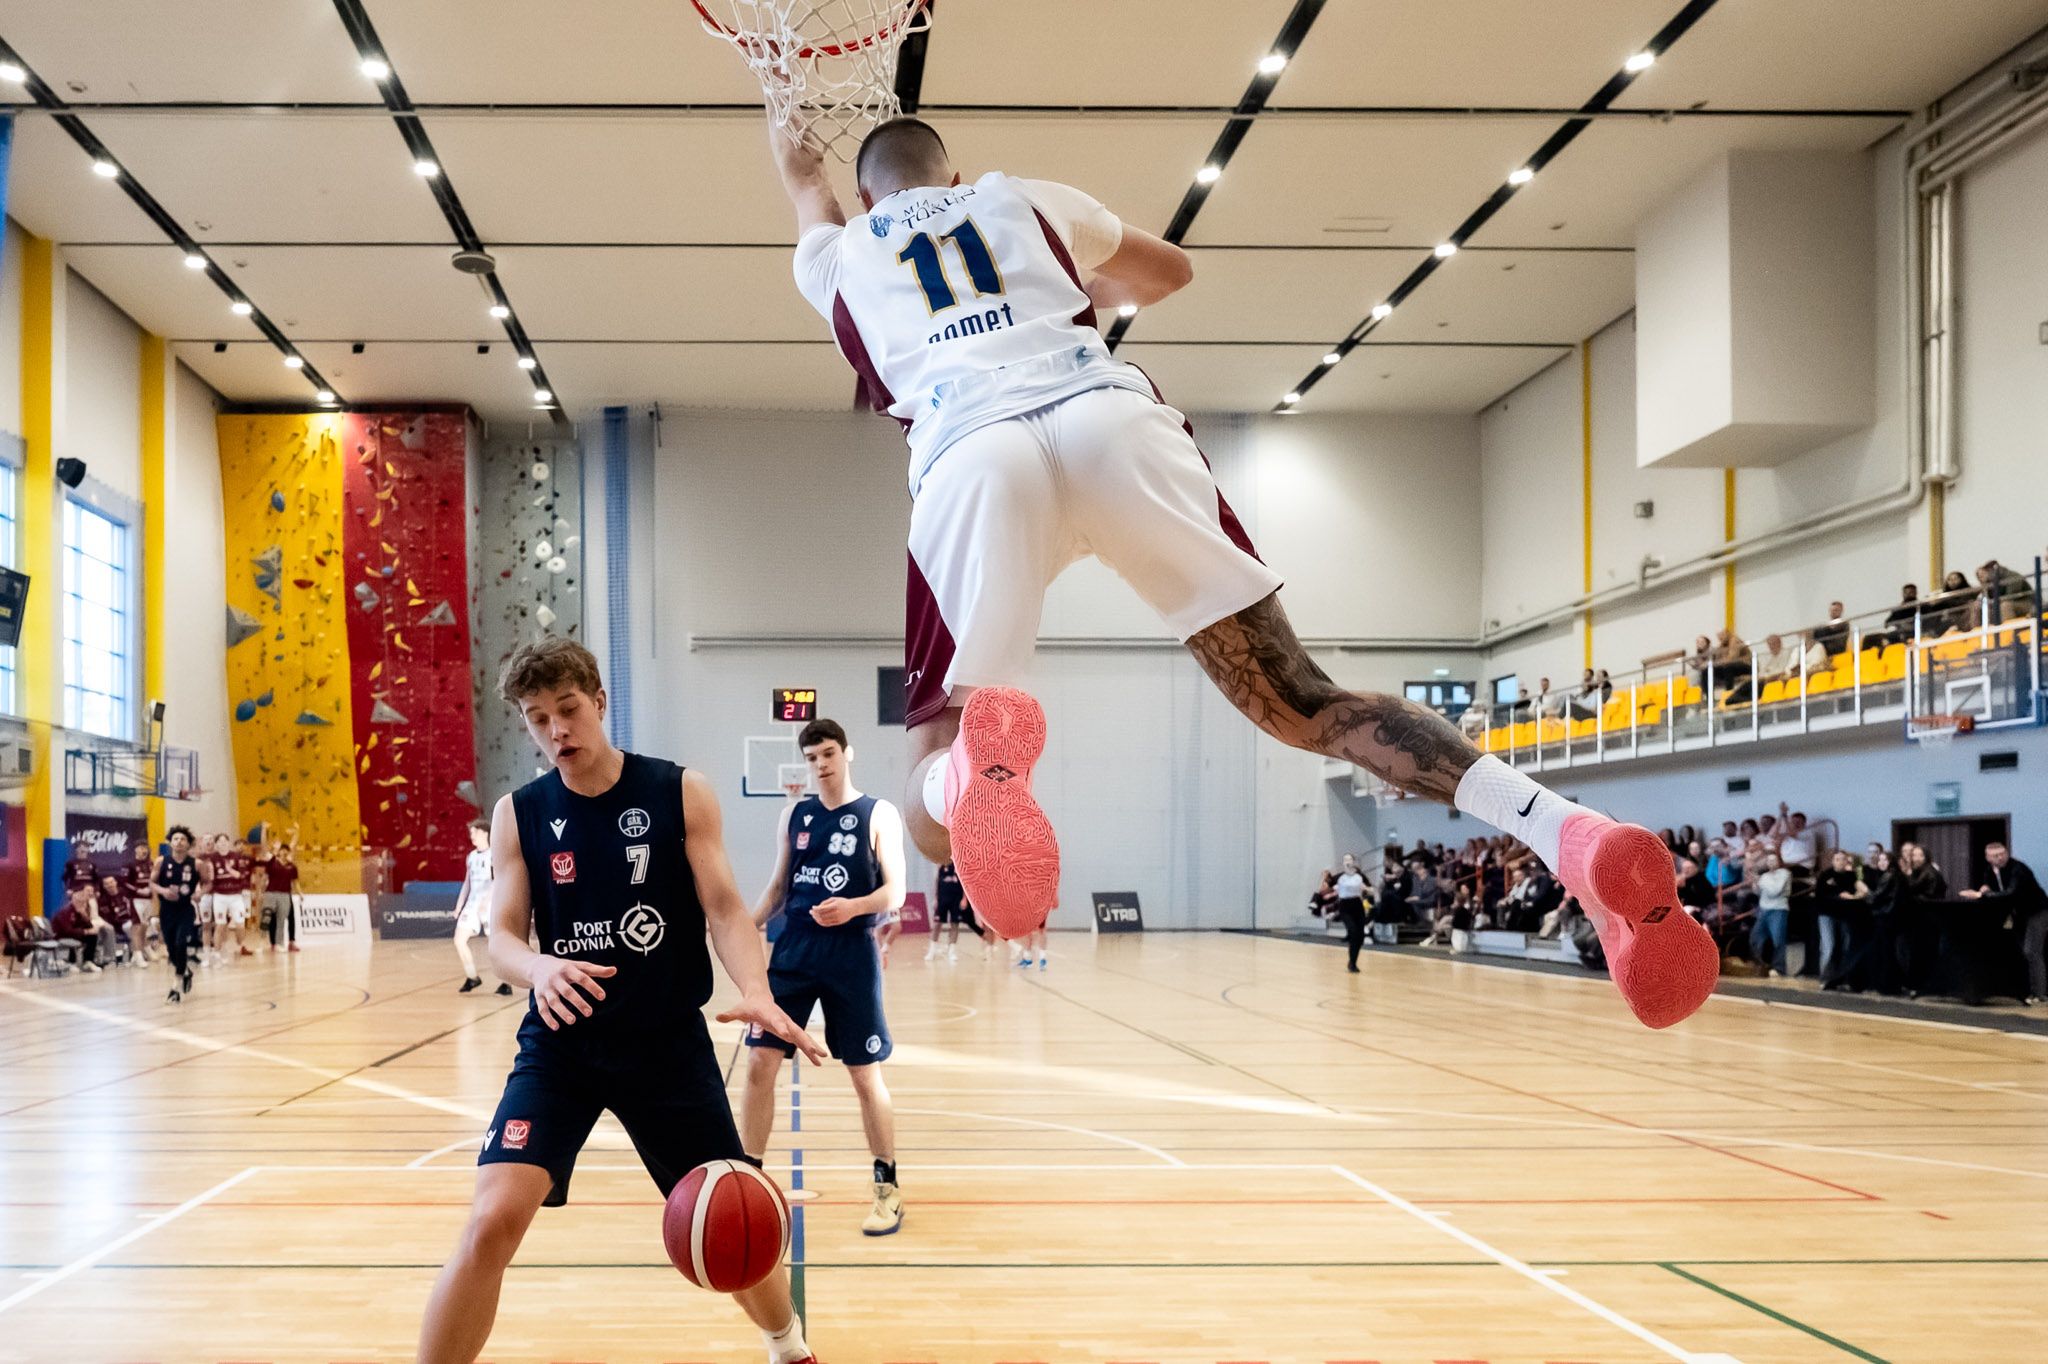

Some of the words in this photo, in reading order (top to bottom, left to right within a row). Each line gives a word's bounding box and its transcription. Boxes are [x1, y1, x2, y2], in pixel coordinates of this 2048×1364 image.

[895, 213, 1007, 318] 11
[828, 832, 858, 856] 33
[625, 844, 650, 885] 7
[573, 920, 613, 938] PORT
[553, 935, 616, 955] GDYNIA
